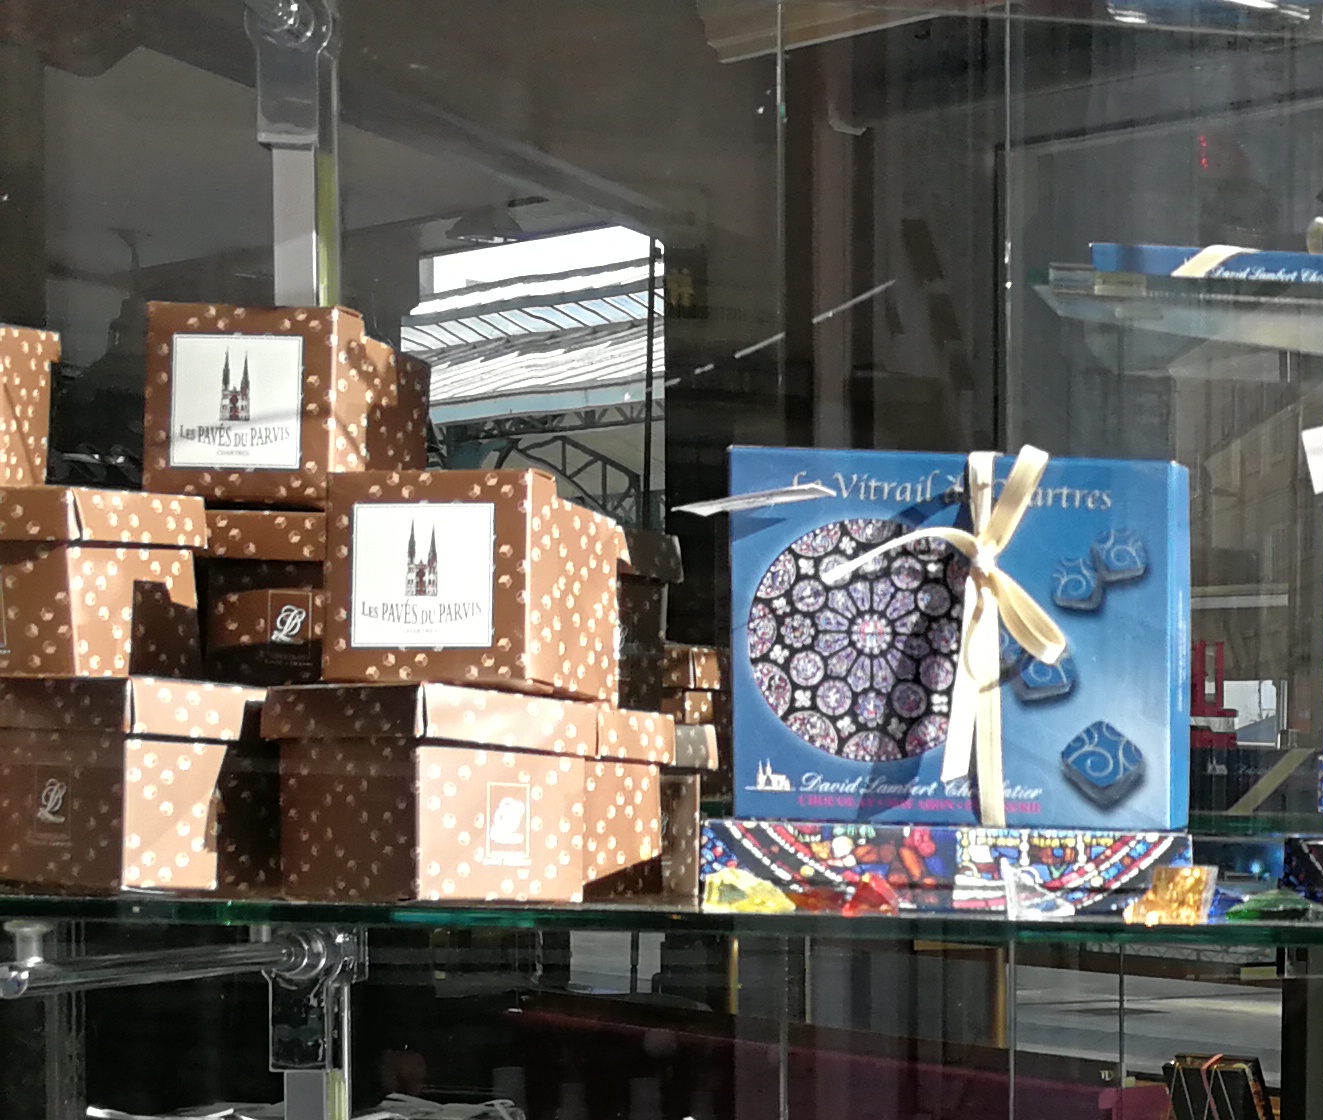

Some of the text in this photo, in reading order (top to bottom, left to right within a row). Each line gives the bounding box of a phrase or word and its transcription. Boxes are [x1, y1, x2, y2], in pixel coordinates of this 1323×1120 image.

[250, 426, 290, 447] PARVIS
[833, 469, 941, 501] Vitrail
[381, 599, 418, 625] PAVÉS
[438, 602, 482, 624] PARVIS
[801, 772, 864, 793] David
